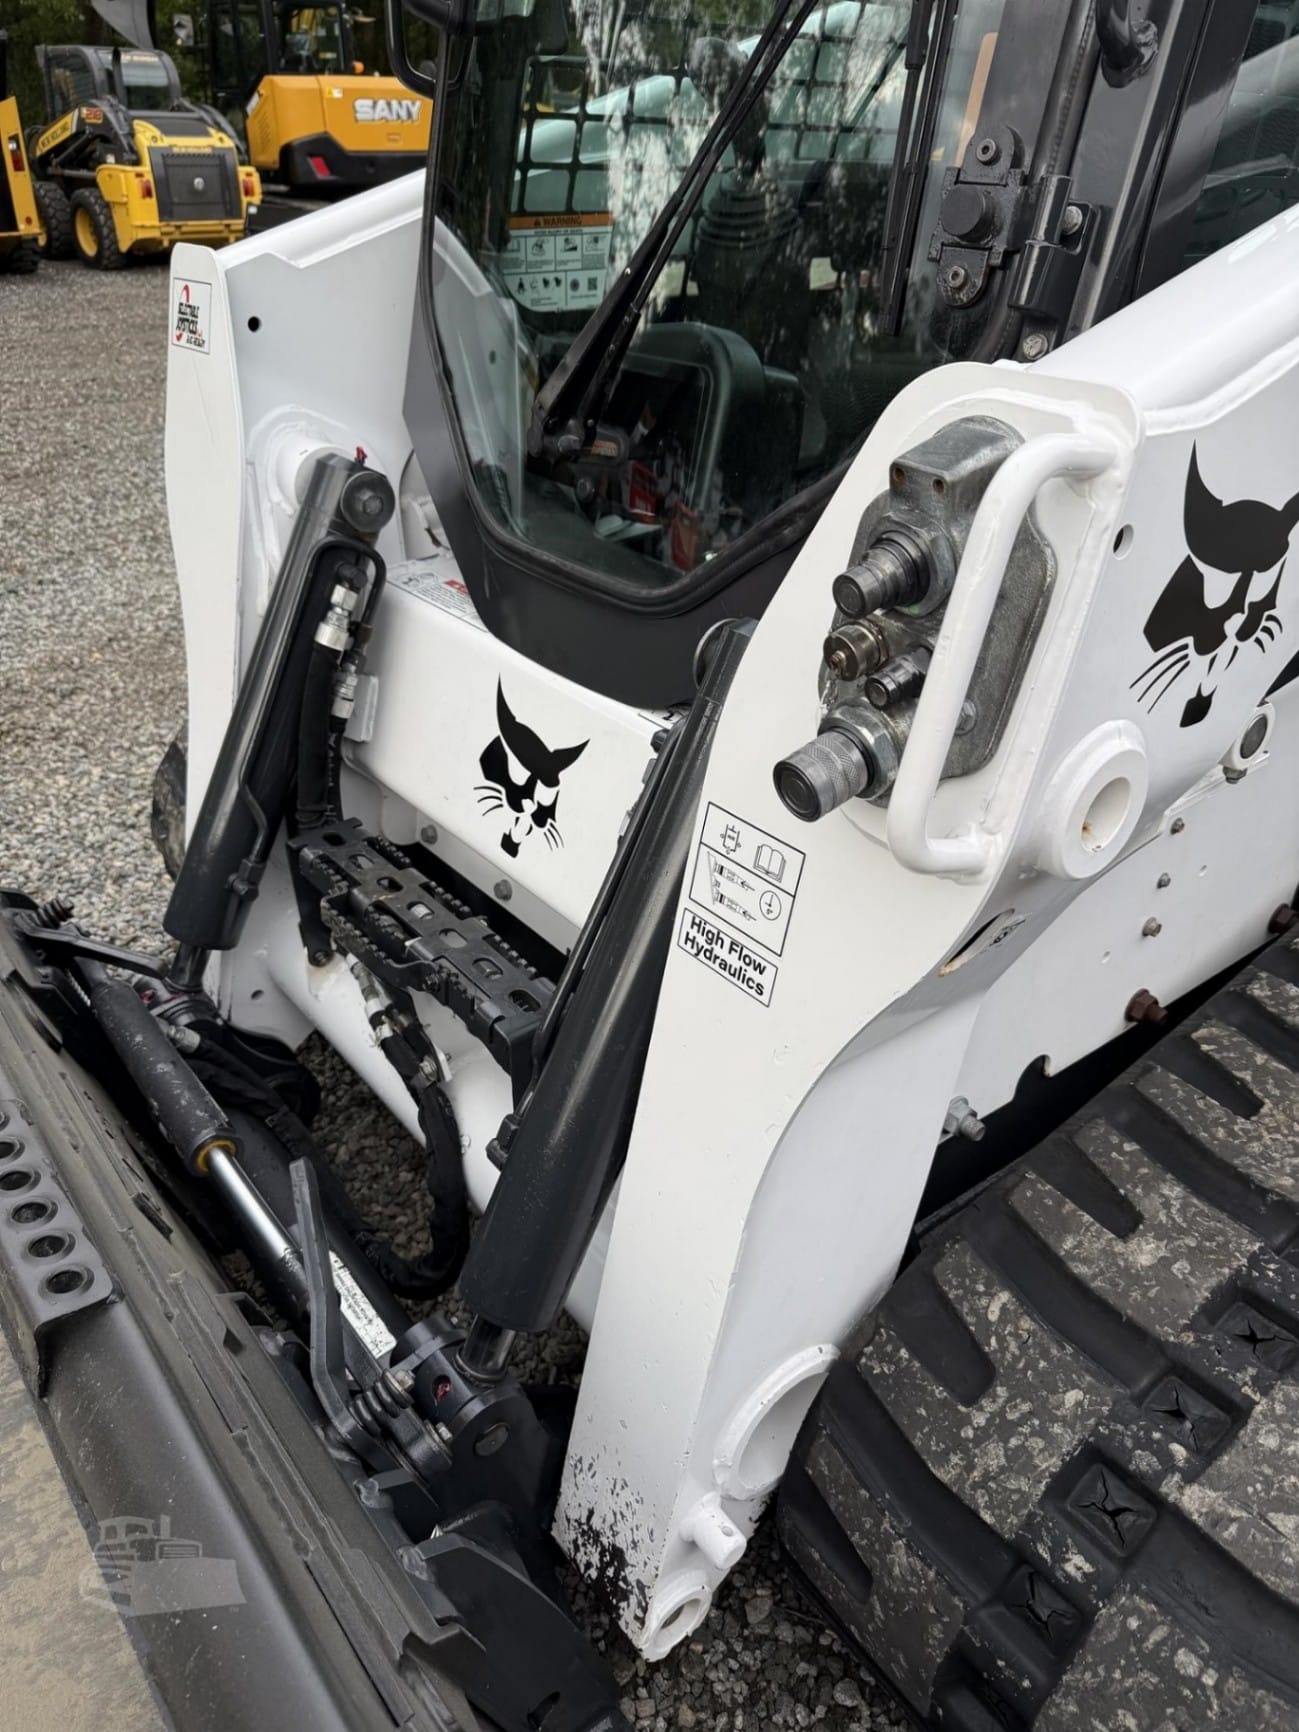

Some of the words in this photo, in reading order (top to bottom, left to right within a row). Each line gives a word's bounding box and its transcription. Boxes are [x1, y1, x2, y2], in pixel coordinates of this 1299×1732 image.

[354, 98, 421, 122] SANY
[543, 215, 582, 227] WARNING
[684, 931, 765, 997] Hydraulics
[690, 915, 725, 950] High
[728, 941, 767, 976] Flow
